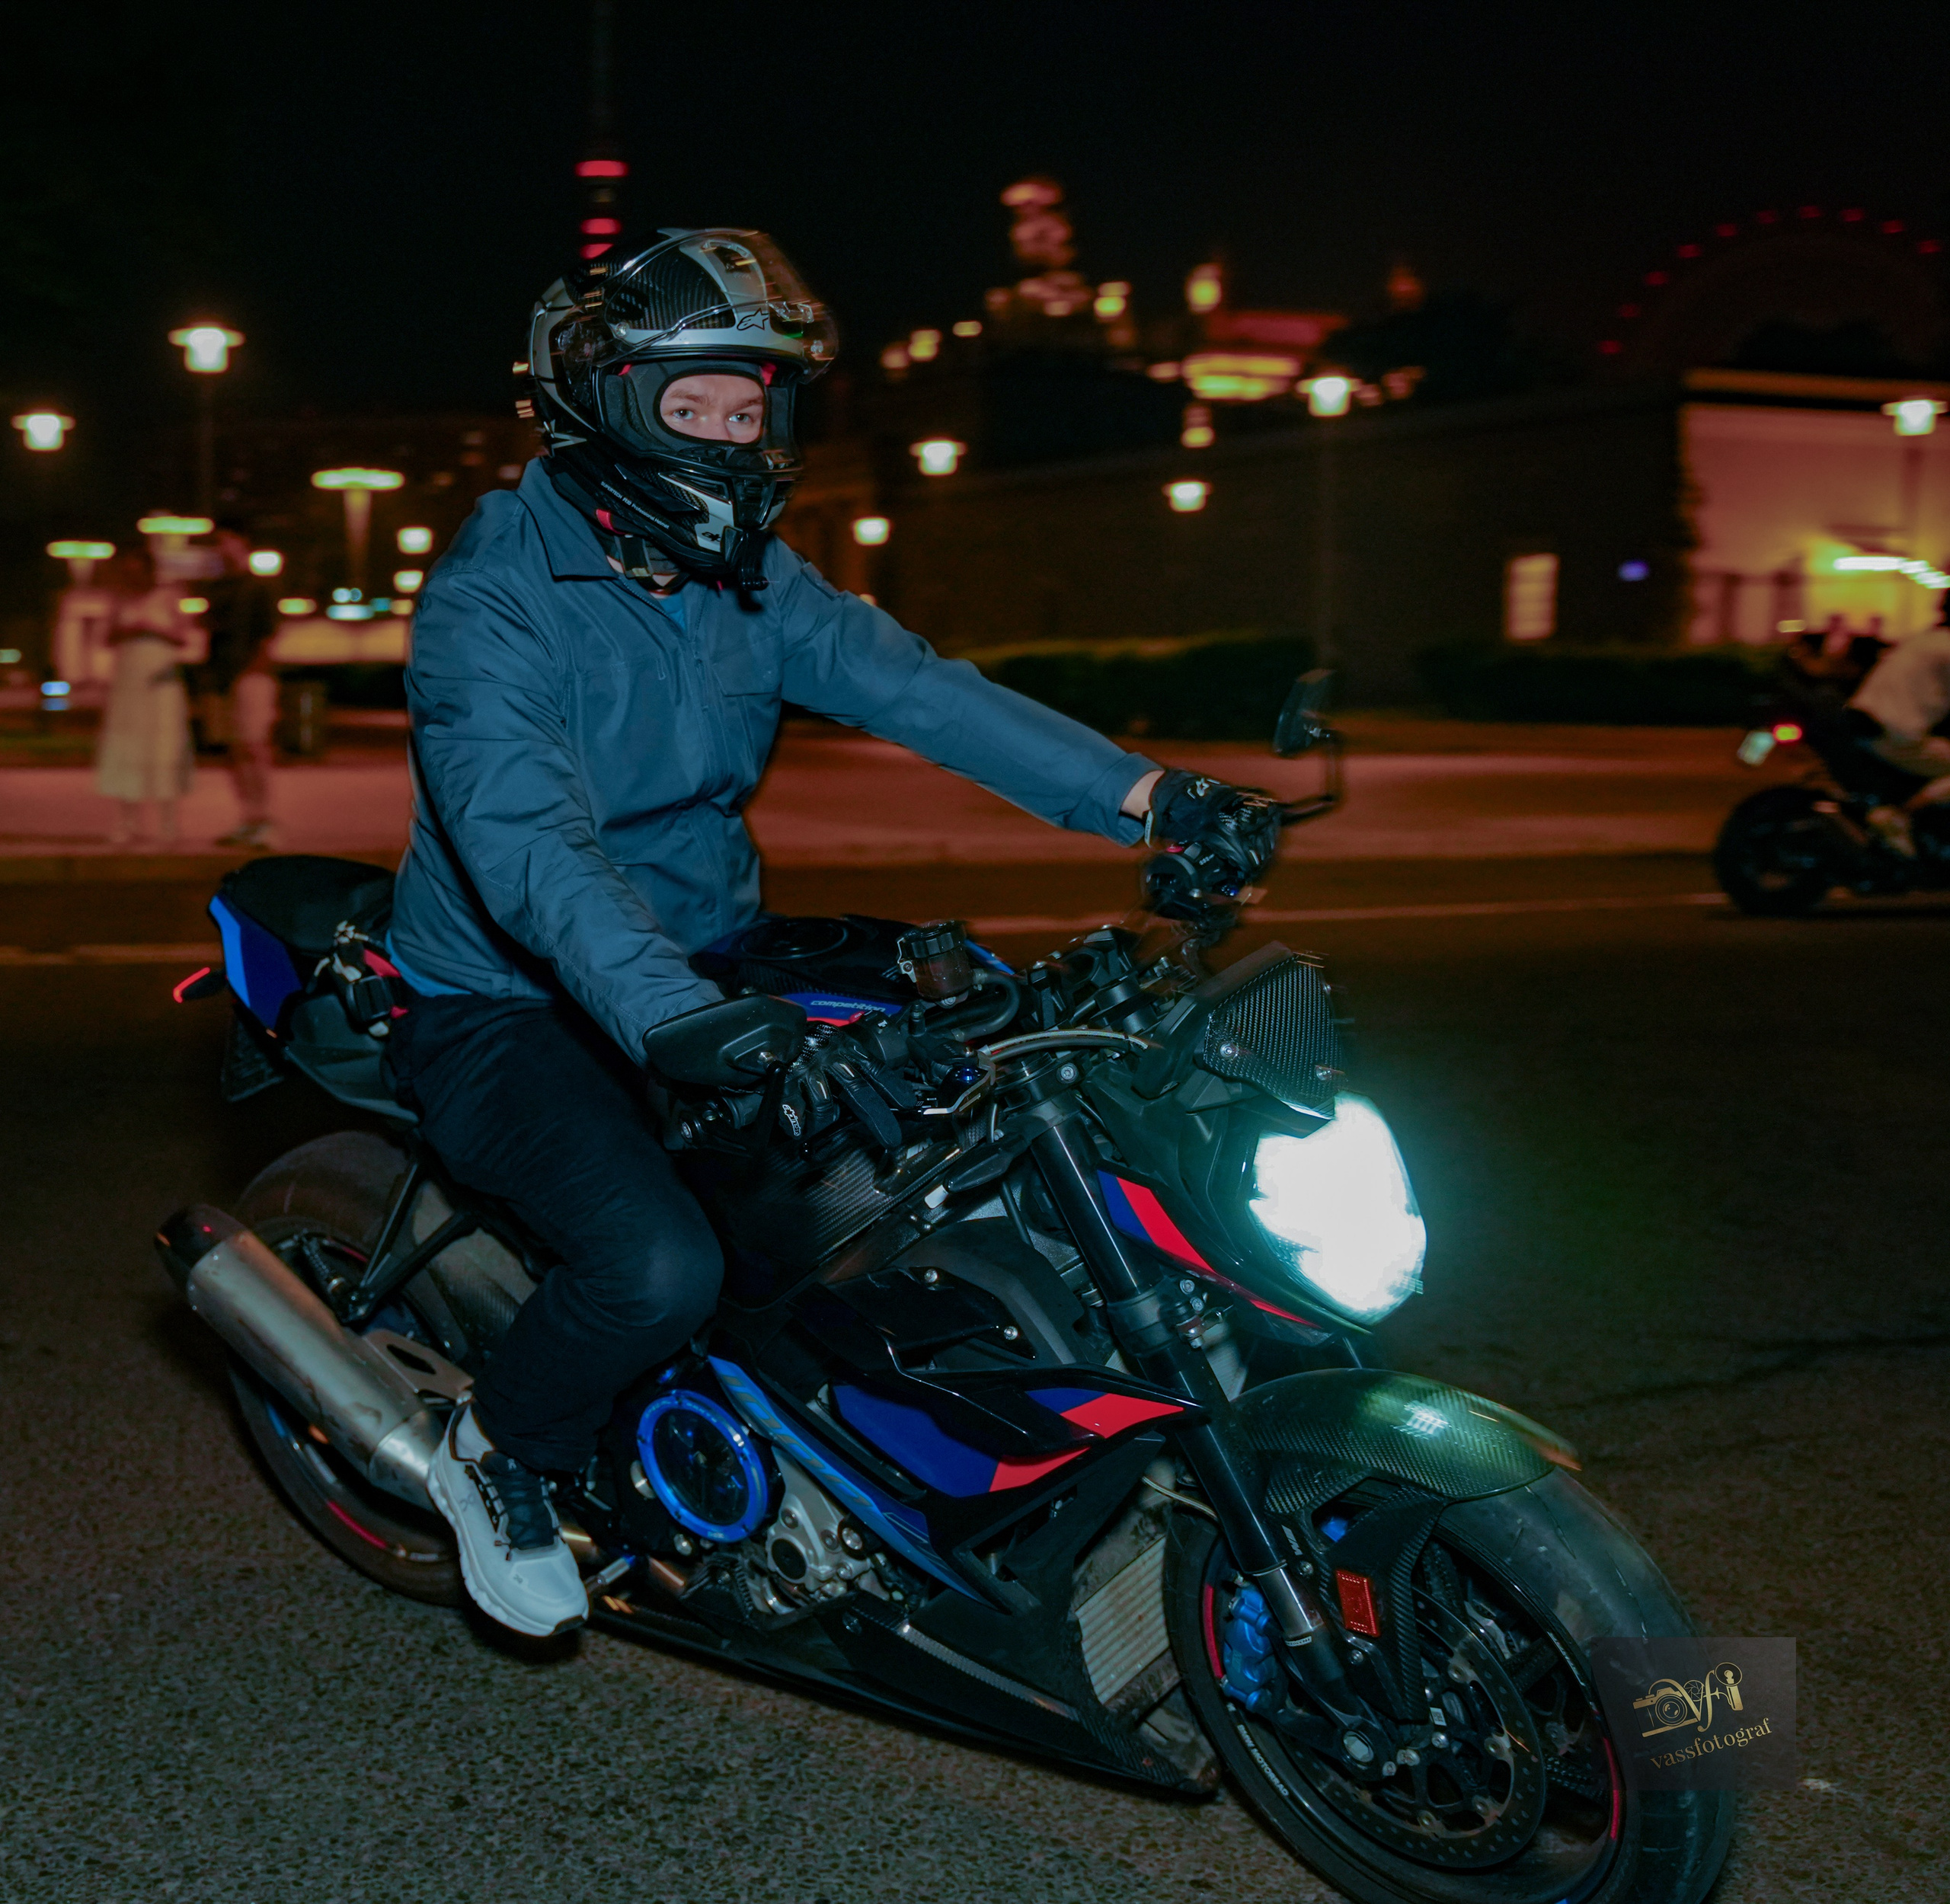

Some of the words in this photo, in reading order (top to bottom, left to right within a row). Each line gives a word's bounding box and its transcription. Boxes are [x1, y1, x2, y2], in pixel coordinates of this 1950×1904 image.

[810, 1000, 886, 1012] competition
[1237, 1724, 1255, 1748] BMW
[1251, 1748, 1290, 1797] MOTORRAD
